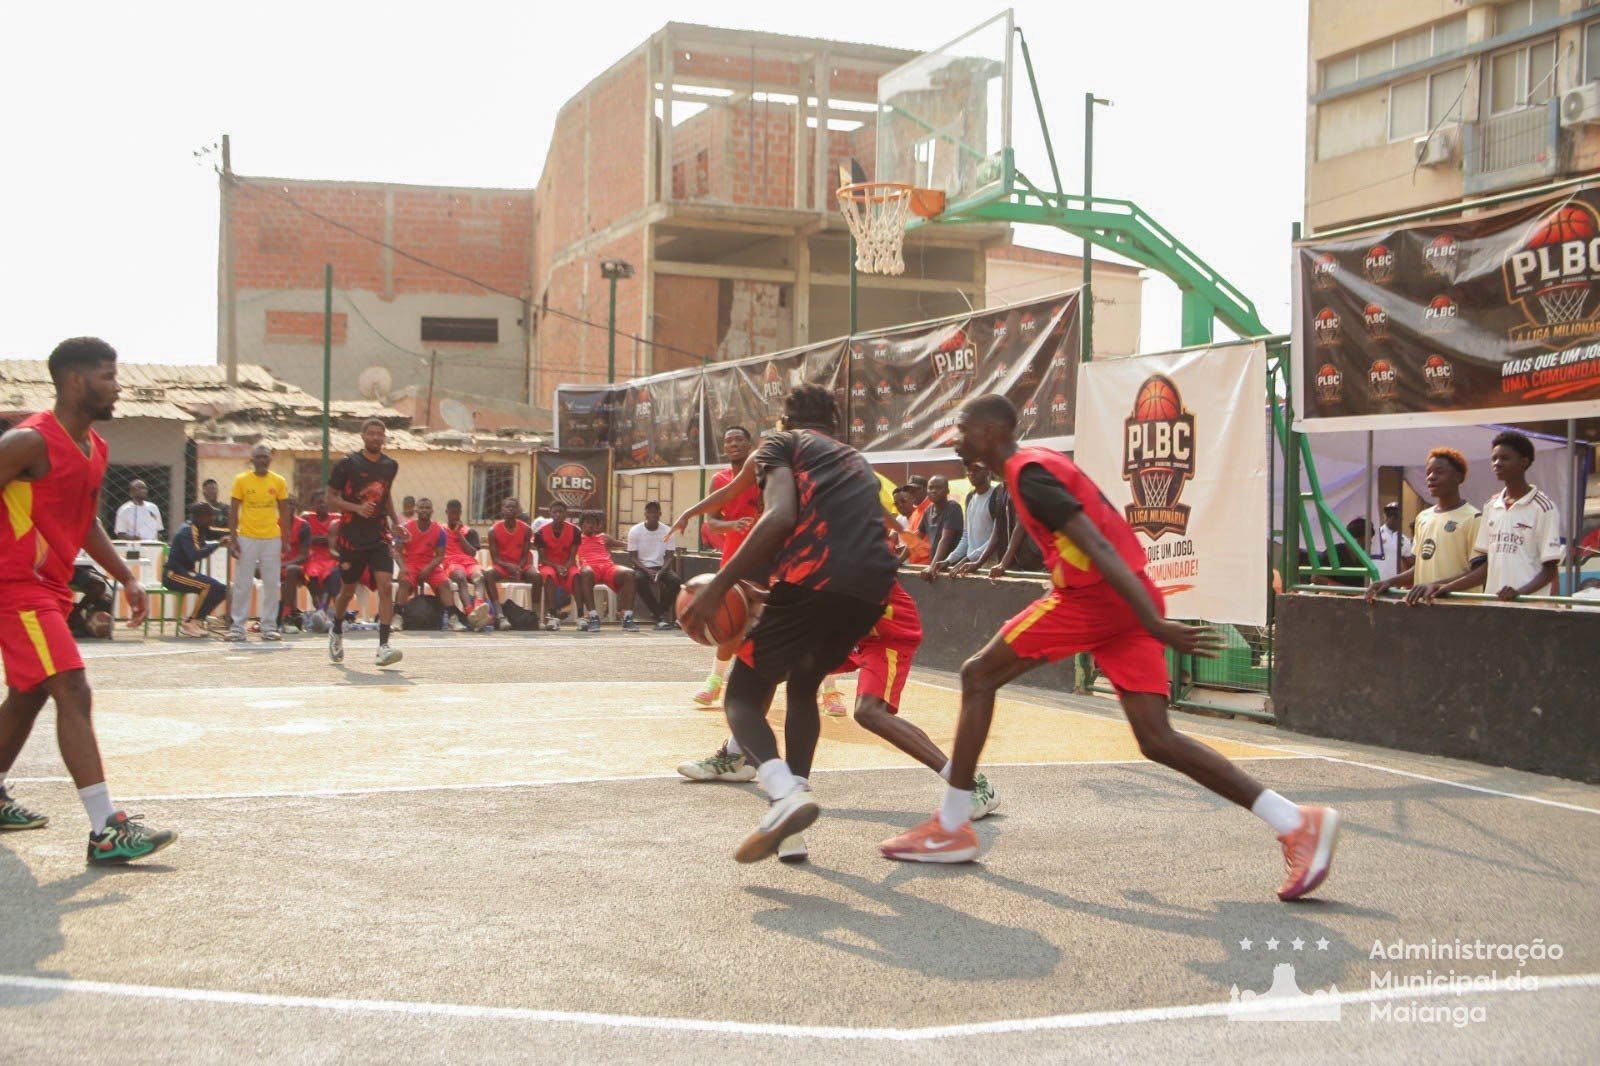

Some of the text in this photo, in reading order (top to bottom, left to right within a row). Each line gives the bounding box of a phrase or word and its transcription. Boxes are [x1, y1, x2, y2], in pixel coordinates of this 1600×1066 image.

[1425, 245, 1457, 258] PLBC
[1365, 254, 1392, 268] PLBC
[1424, 306, 1456, 320] PLBC
[1314, 318, 1339, 330] PLBC
[1526, 326, 1549, 340] LIGA
[934, 348, 974, 374] PLBC
[1502, 358, 1531, 377] MAIS
[1534, 352, 1559, 370] QUE
[1560, 347, 1581, 365] UM
[1370, 370, 1395, 382] PLBC
[1425, 365, 1451, 378] PLBC
[1317, 375, 1341, 386] PLBC
[1502, 373, 1529, 393] UMA
[1127, 421, 1191, 461] PLBC
[551, 476, 593, 490] PLBC
[1134, 509, 1149, 524] LIGA
[1148, 540, 1195, 563] QUE UM JOGO,
